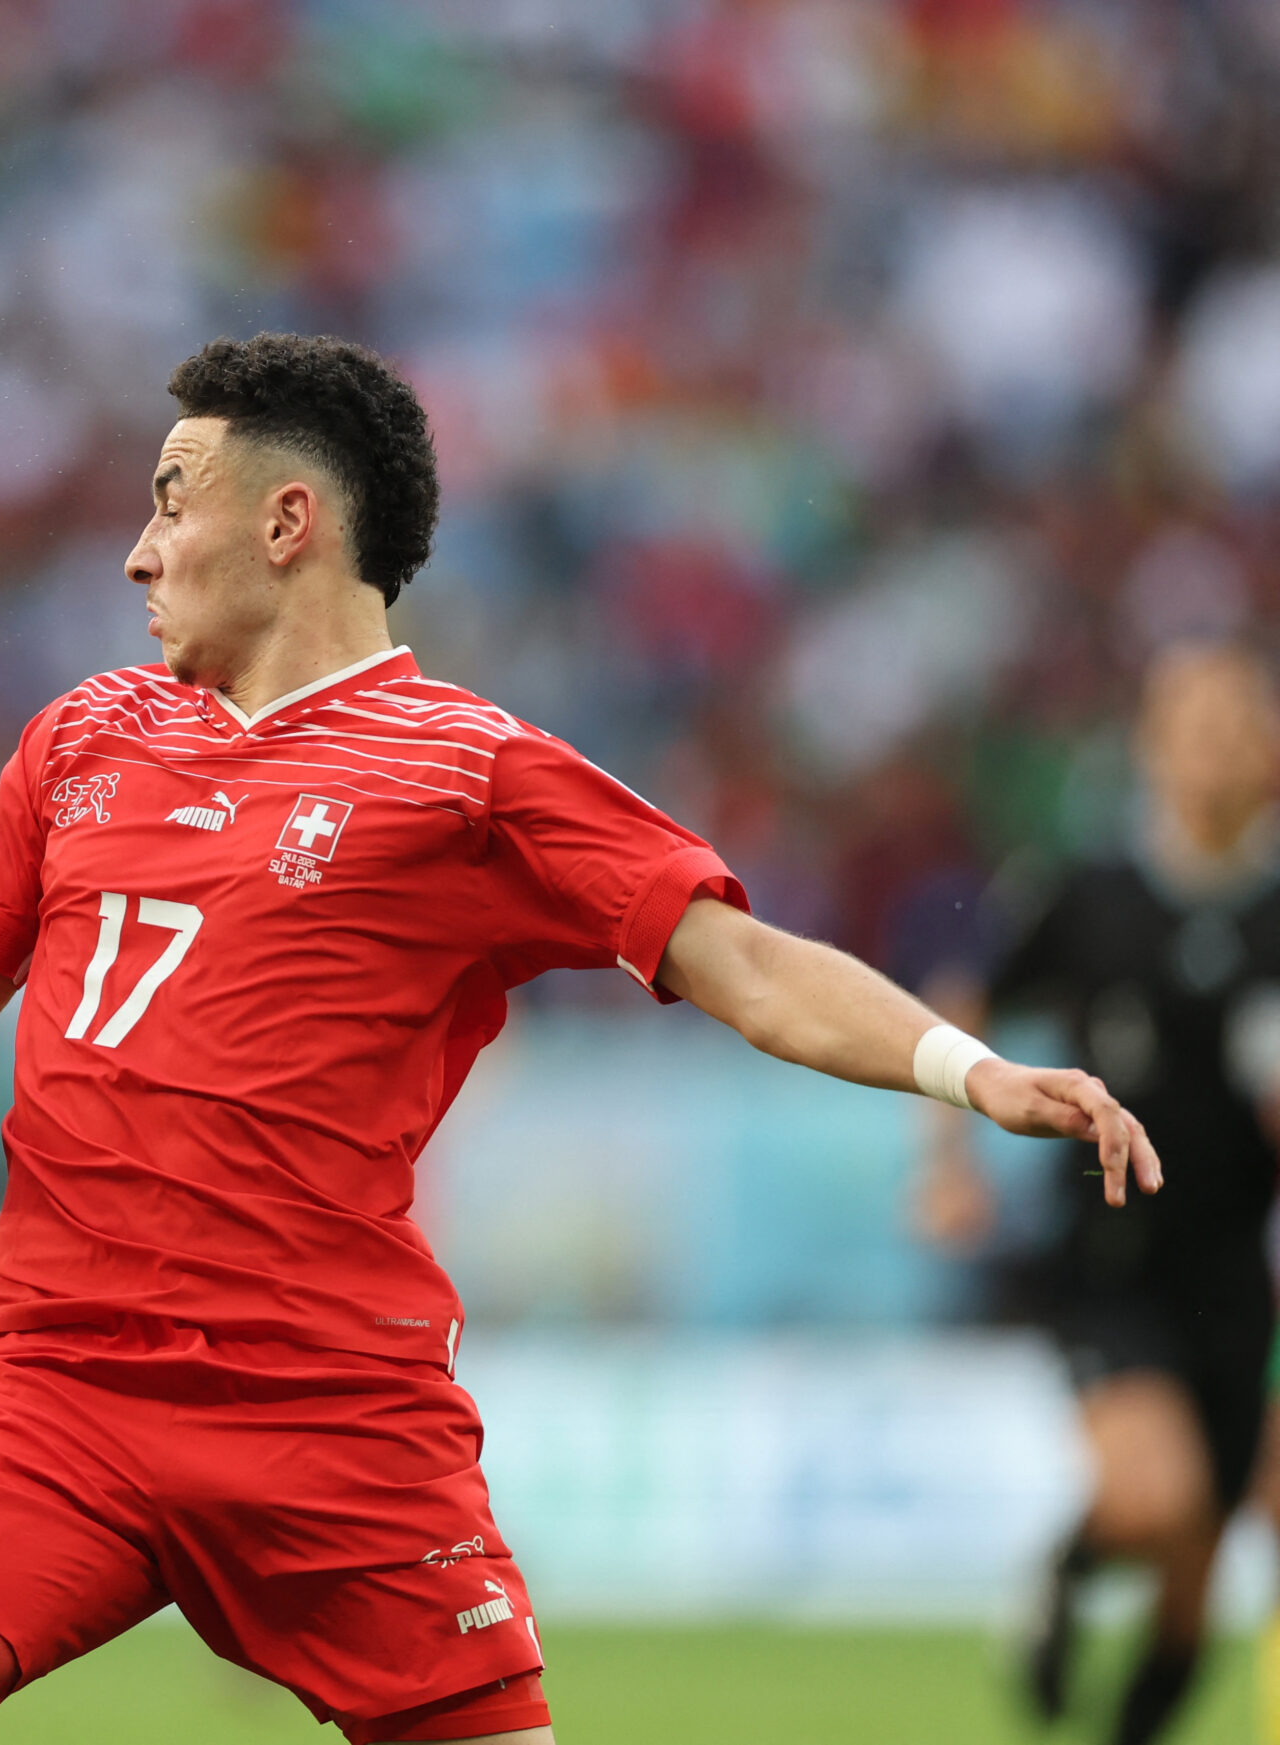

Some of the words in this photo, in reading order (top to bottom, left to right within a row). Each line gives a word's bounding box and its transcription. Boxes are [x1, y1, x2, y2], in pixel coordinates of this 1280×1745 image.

[164, 806, 228, 832] PUMA
[267, 858, 288, 875] SUI
[294, 865, 323, 885] CMR
[277, 874, 306, 890] QATAR
[64, 890, 205, 1049] 17
[374, 1316, 431, 1329] ULTRAWEAVE
[456, 1597, 515, 1635] PUMA
